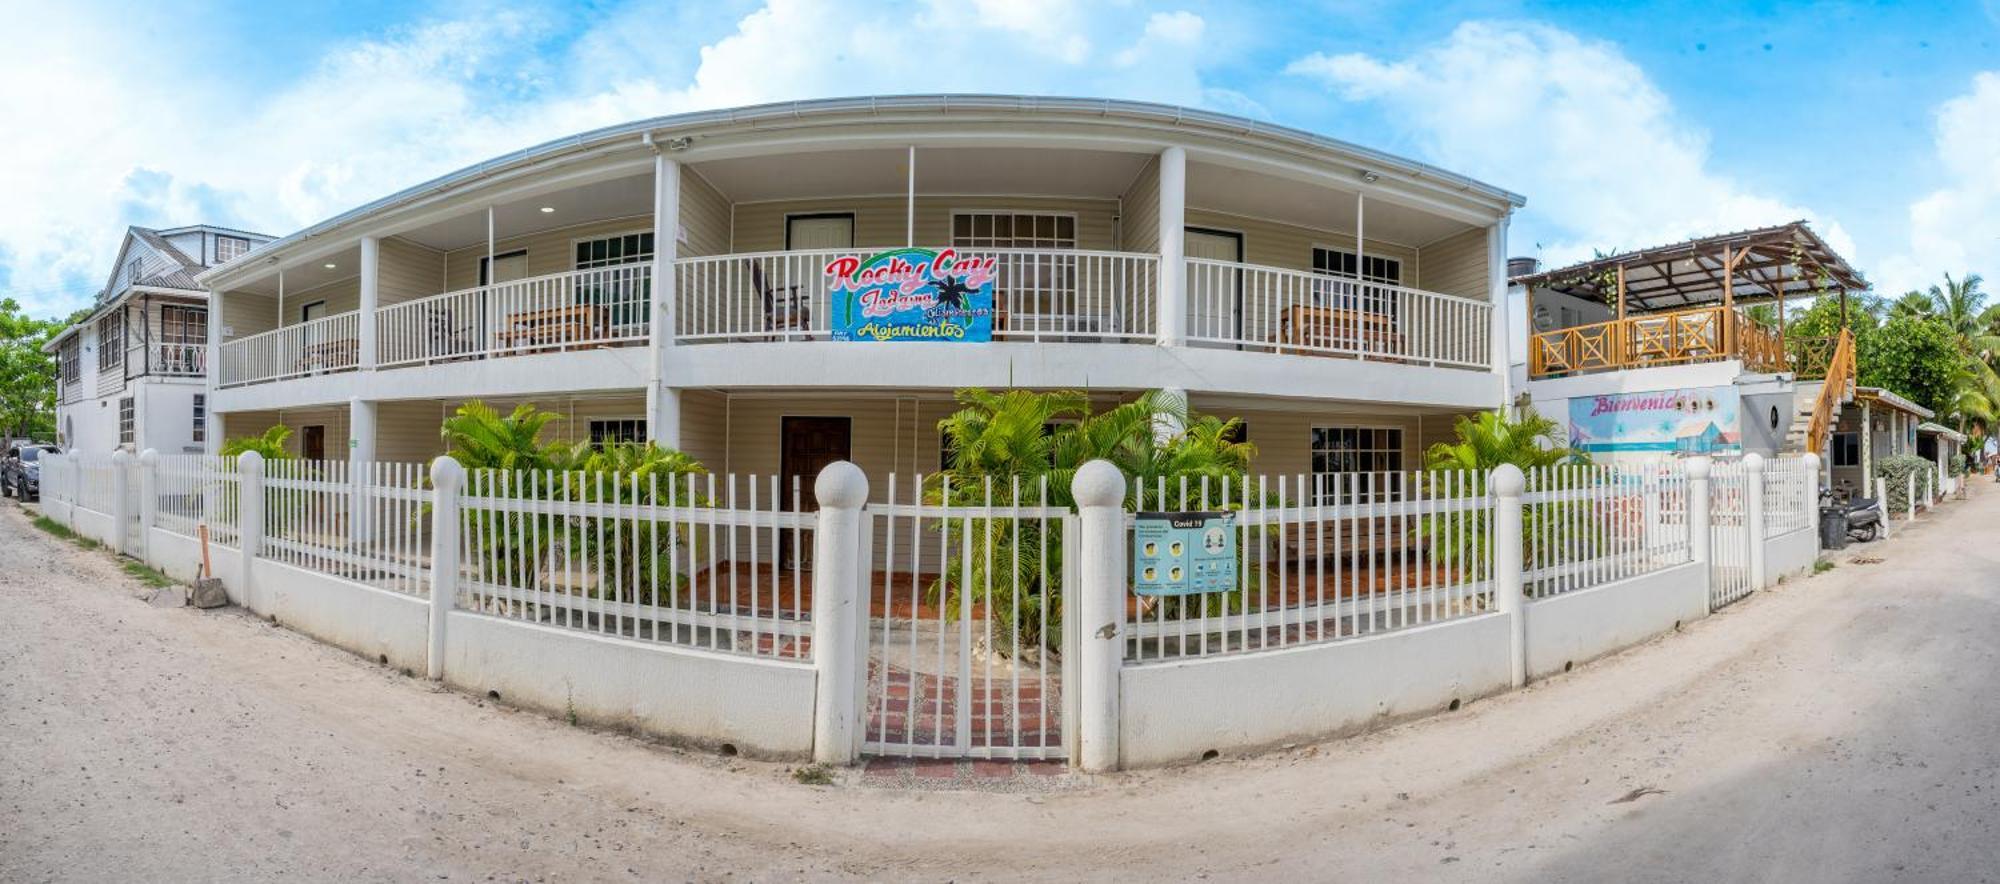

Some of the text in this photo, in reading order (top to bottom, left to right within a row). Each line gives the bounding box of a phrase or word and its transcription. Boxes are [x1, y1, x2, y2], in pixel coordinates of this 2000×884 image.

[825, 247, 997, 295] Rocky Cay
[857, 320, 965, 341] Alojamientos
[1174, 519, 1202, 528] Covid 19
